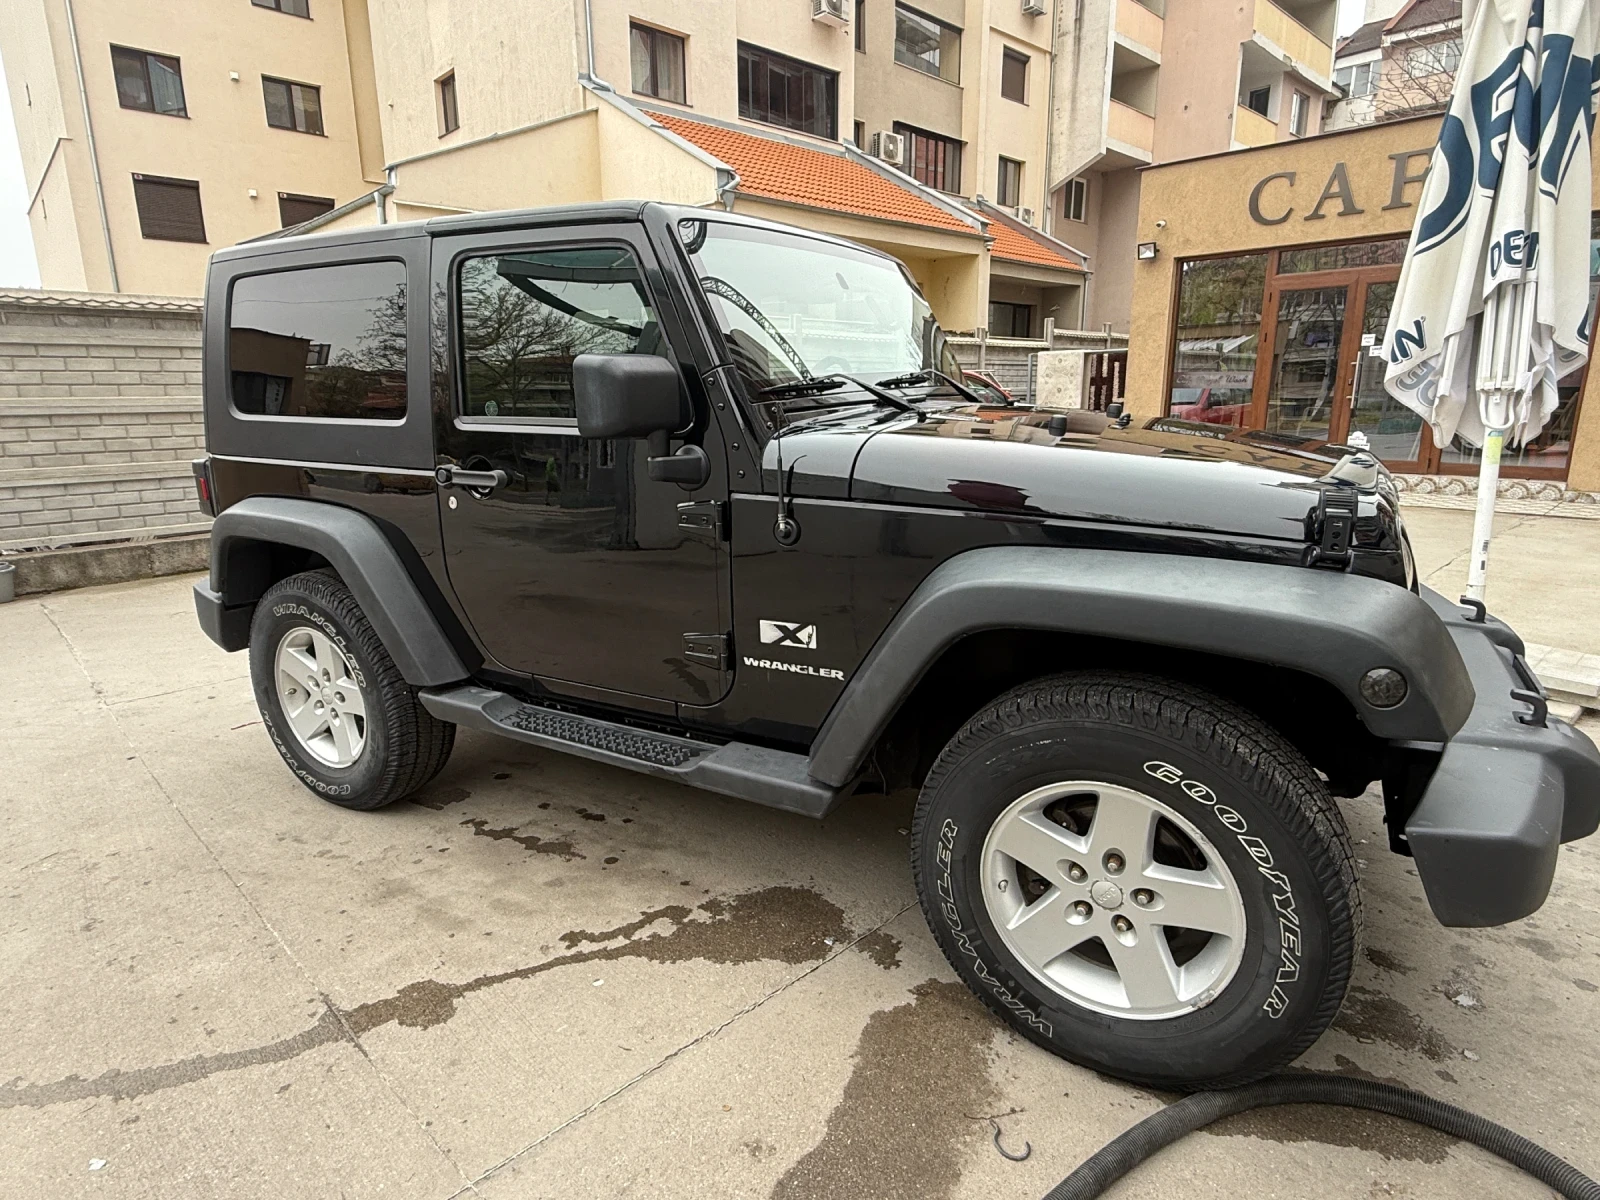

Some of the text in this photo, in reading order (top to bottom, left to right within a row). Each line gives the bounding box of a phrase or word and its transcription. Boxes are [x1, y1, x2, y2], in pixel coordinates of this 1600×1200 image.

[273, 603, 367, 688] WRANGLER
[743, 656, 845, 681] WRANGLER
[937, 818, 1053, 1038] WRANGLER
[1143, 760, 1301, 1019] GOODYEAR
